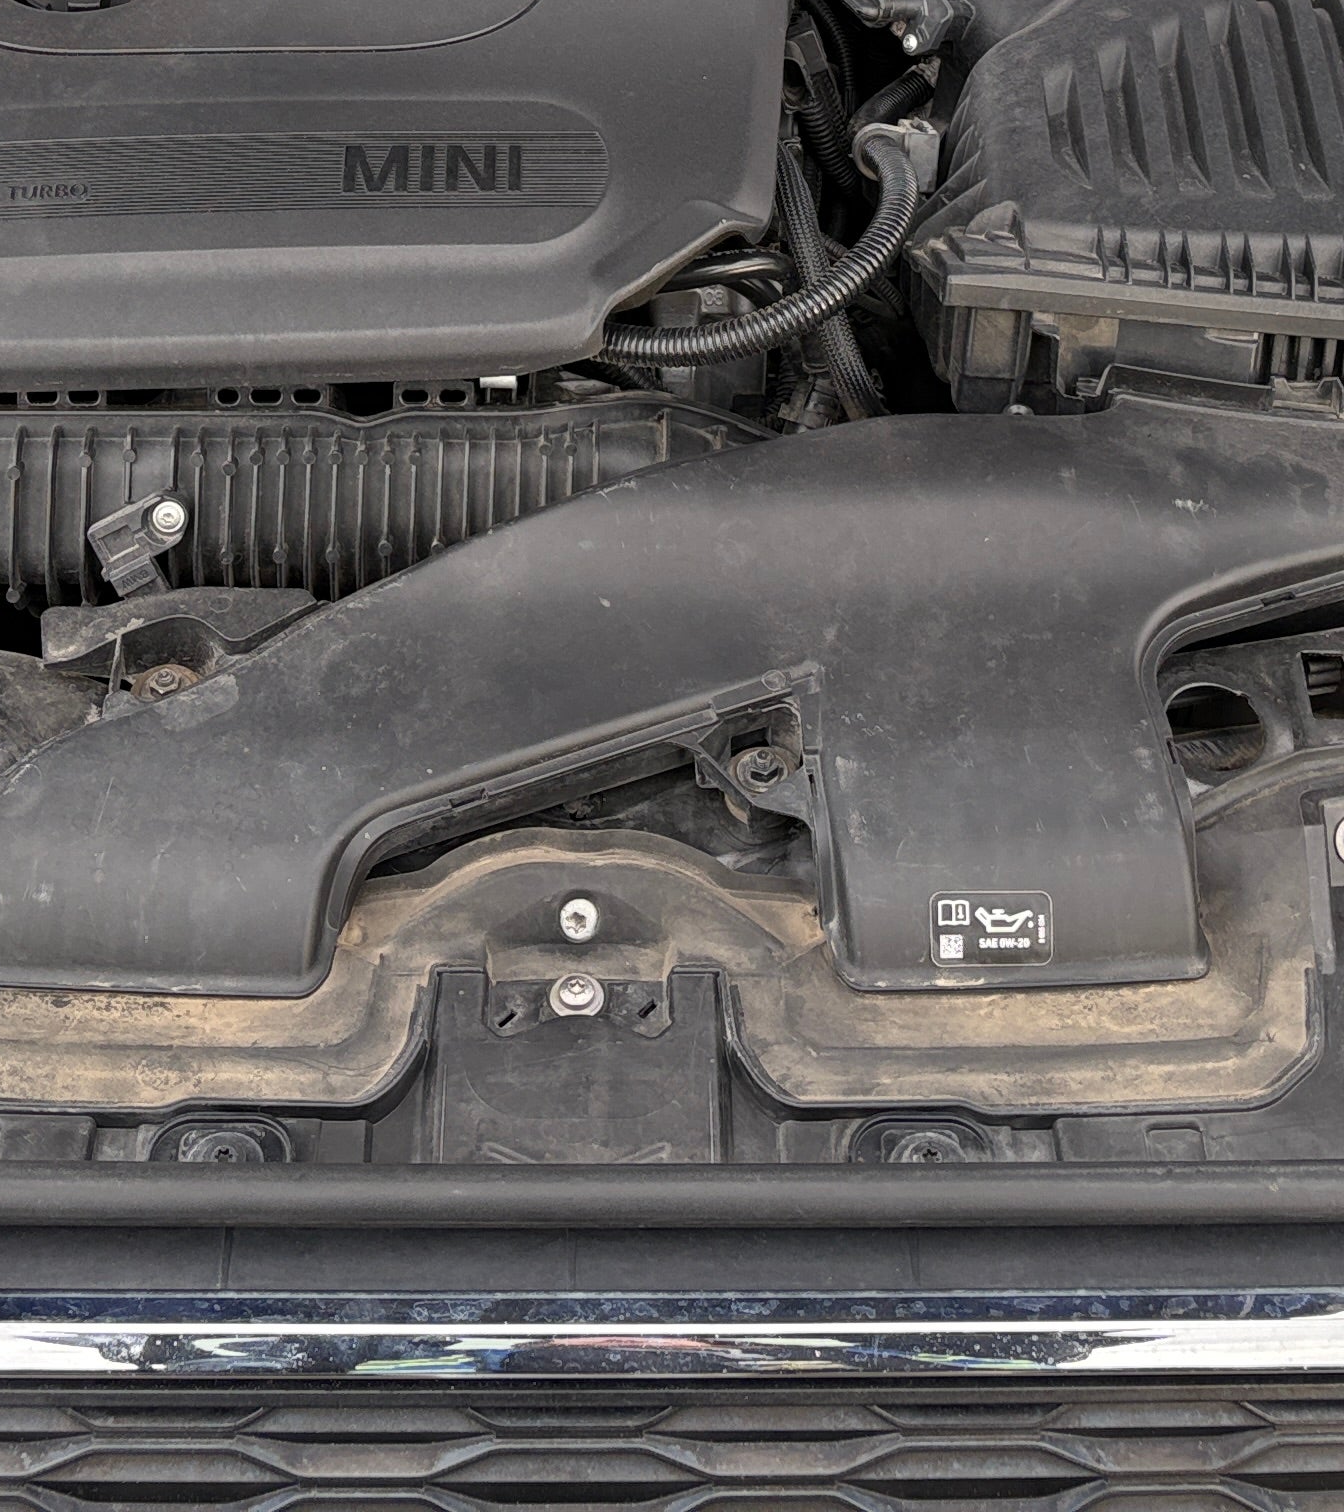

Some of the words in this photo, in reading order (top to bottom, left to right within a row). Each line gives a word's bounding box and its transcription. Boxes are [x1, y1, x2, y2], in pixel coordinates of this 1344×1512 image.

[342, 145, 522, 193] MINI
[8, 183, 90, 202] TURBO
[979, 938, 998, 949] SAE
[999, 938, 1031, 949] 0W-20
